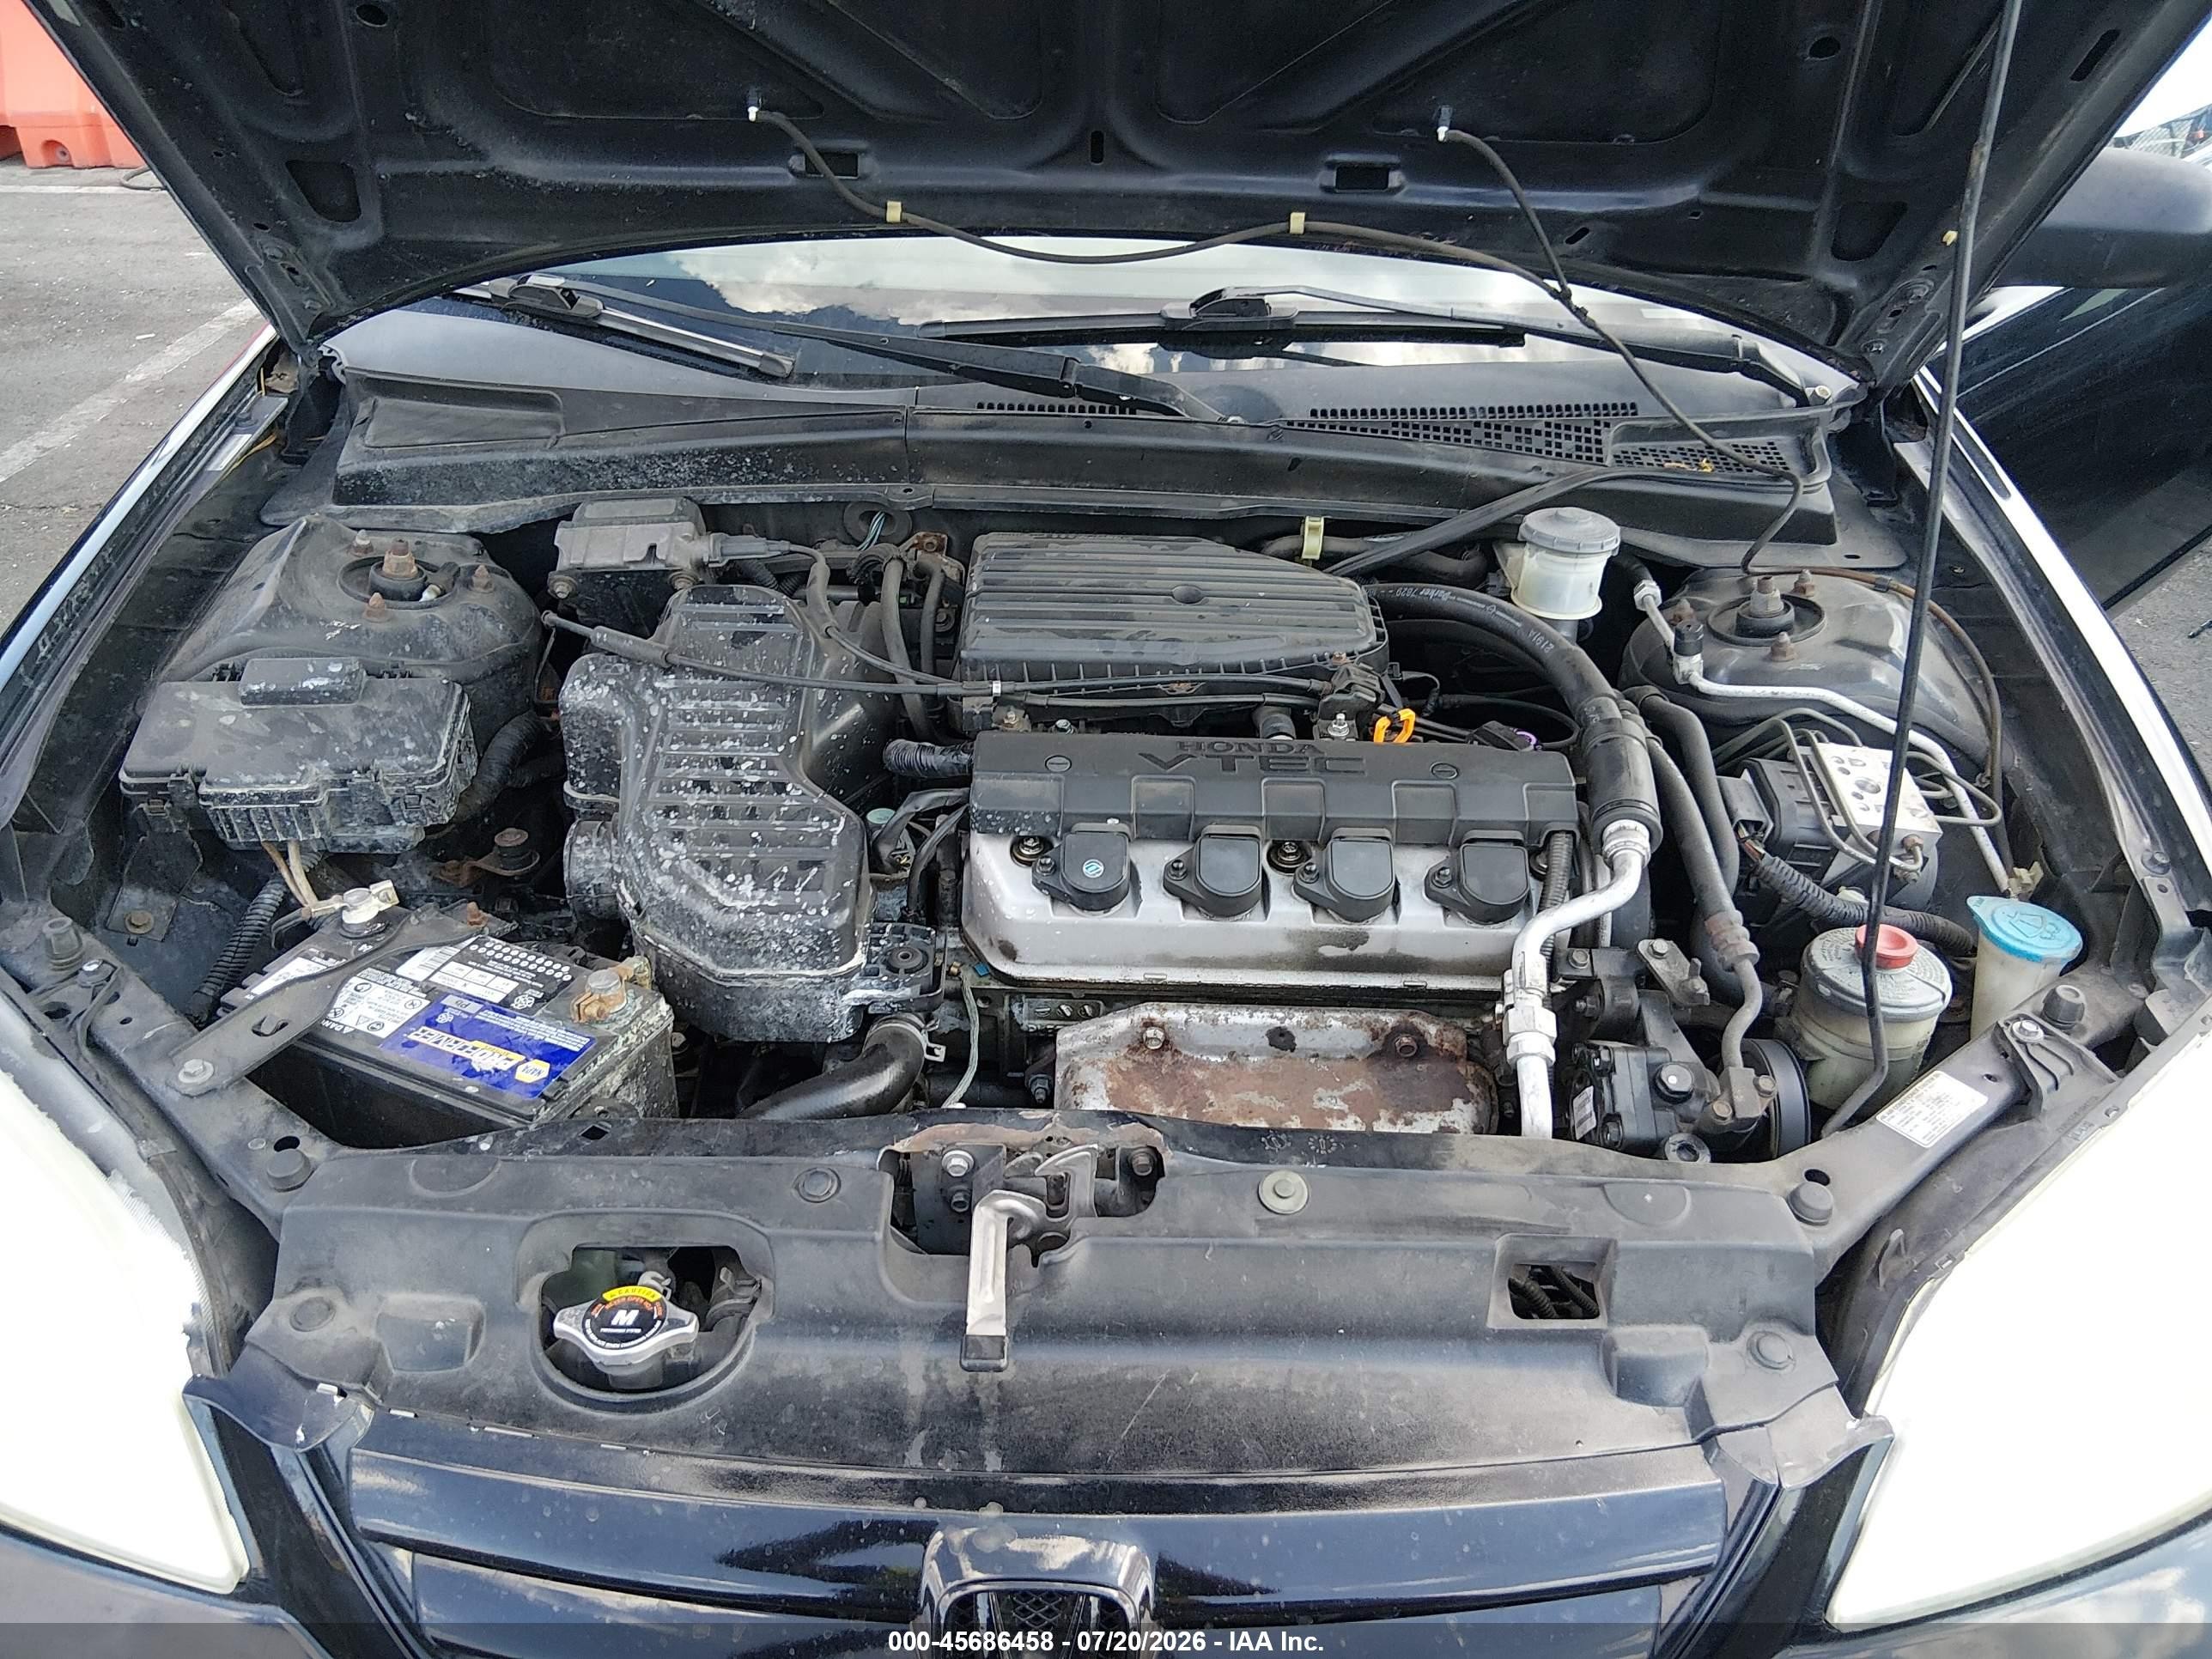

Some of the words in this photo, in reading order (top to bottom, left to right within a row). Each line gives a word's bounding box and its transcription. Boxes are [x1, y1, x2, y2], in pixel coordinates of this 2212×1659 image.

[1419, 587, 1453, 601] Parker
[1176, 741, 1326, 756] HONDA
[1138, 752, 1367, 775] VTEC
[521, 1064, 545, 1077] NAPA
[617, 1288, 656, 1298] CAUTION
